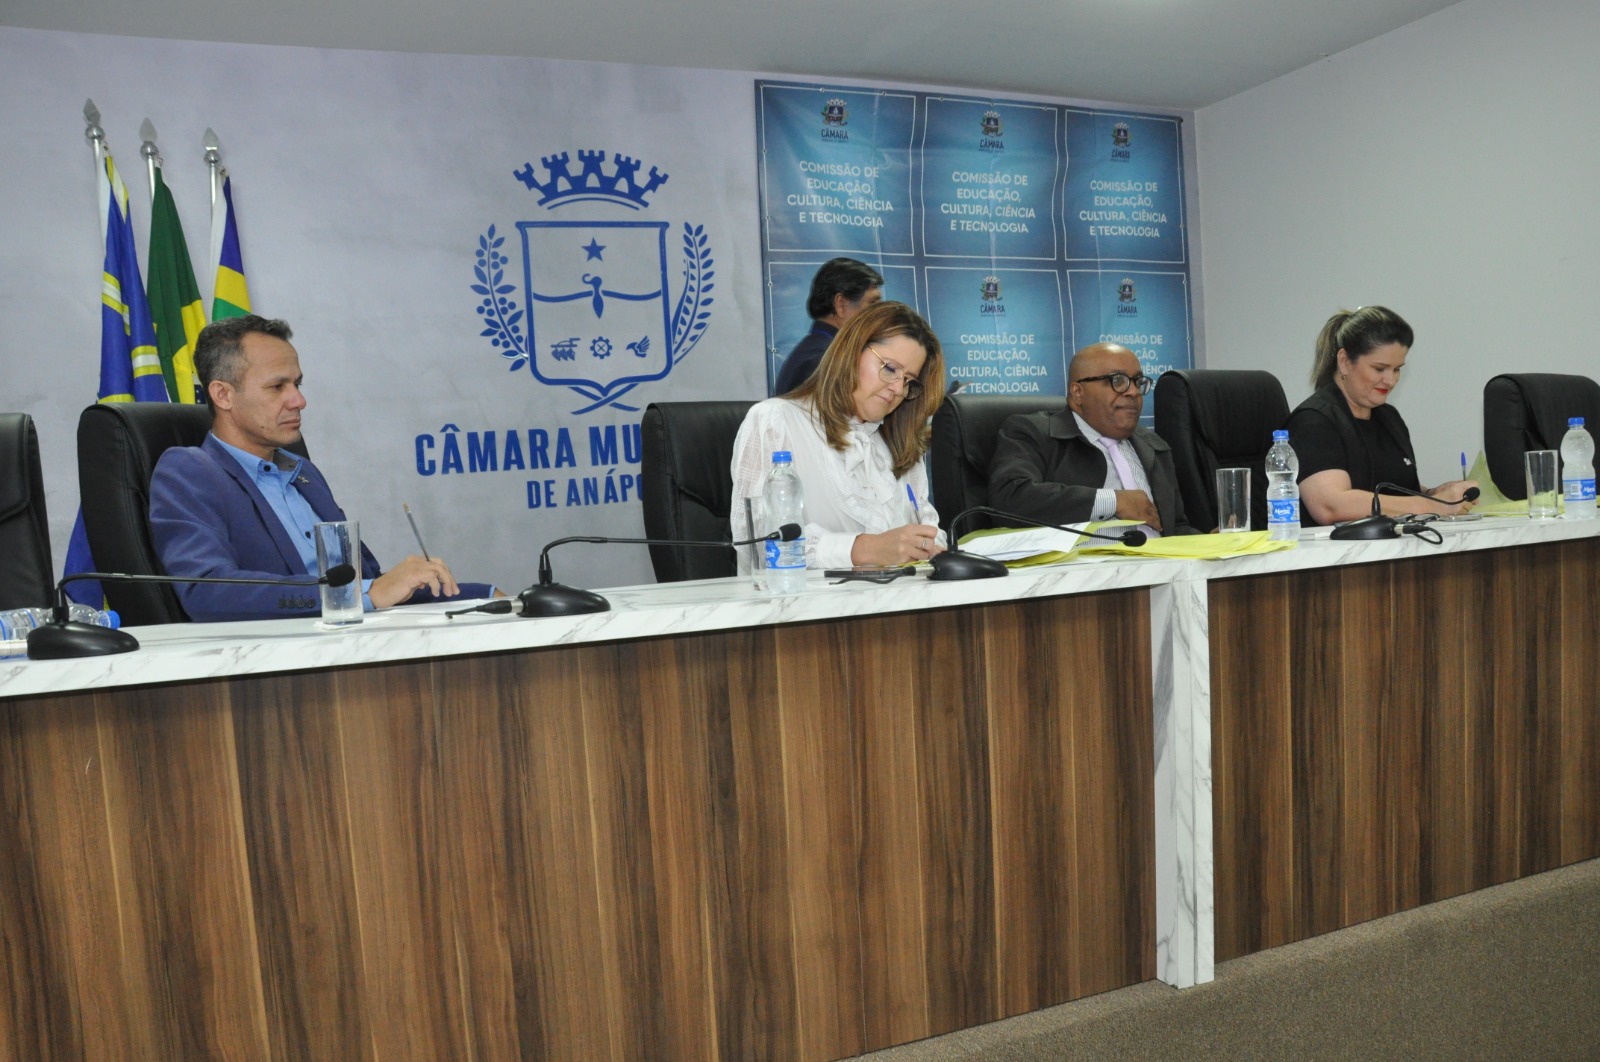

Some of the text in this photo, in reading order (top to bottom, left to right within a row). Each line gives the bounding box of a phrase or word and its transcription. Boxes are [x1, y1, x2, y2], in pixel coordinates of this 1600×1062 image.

[821, 128, 848, 140] CÂMARA
[799, 160, 879, 178] COMISSÃO DE
[952, 171, 1028, 186] COMISSÃO DE
[1090, 179, 1158, 192] COMISSÃO DE
[806, 178, 874, 196] EDUCAÇÃO,
[957, 187, 1022, 203] EDUCAÇÃO,
[1094, 194, 1153, 209] EDUCAÇÃO,
[787, 194, 894, 211] CULTURA, CIÊNCIA
[940, 203, 1036, 218] CULTURA, CIÊNCIA
[1079, 209, 1167, 223] CULTURA, CIÊNCIA
[799, 212, 884, 228] E TECNOLOGIA
[950, 220, 1029, 233] E TECNOLOGIA
[1089, 225, 1160, 238] E TECNOLOGIA
[980, 302, 1006, 313] CÂMARA
[1117, 304, 1138, 314] CÂMARA
[960, 332, 1035, 345] COMISSÃO DE
[1099, 332, 1163, 345] COMISSÃO DE
[967, 348, 1031, 363] EDUCAÇÃO,
[950, 364, 1048, 378] CULTURA, CIÊNCIA
[1142, 362, 1174, 375] IÊNCIA
[969, 382, 1039, 394] TECNOLOGIA
[415, 423, 642, 476] CÂMARA MU
[526, 468, 643, 509] DE ANÁP
